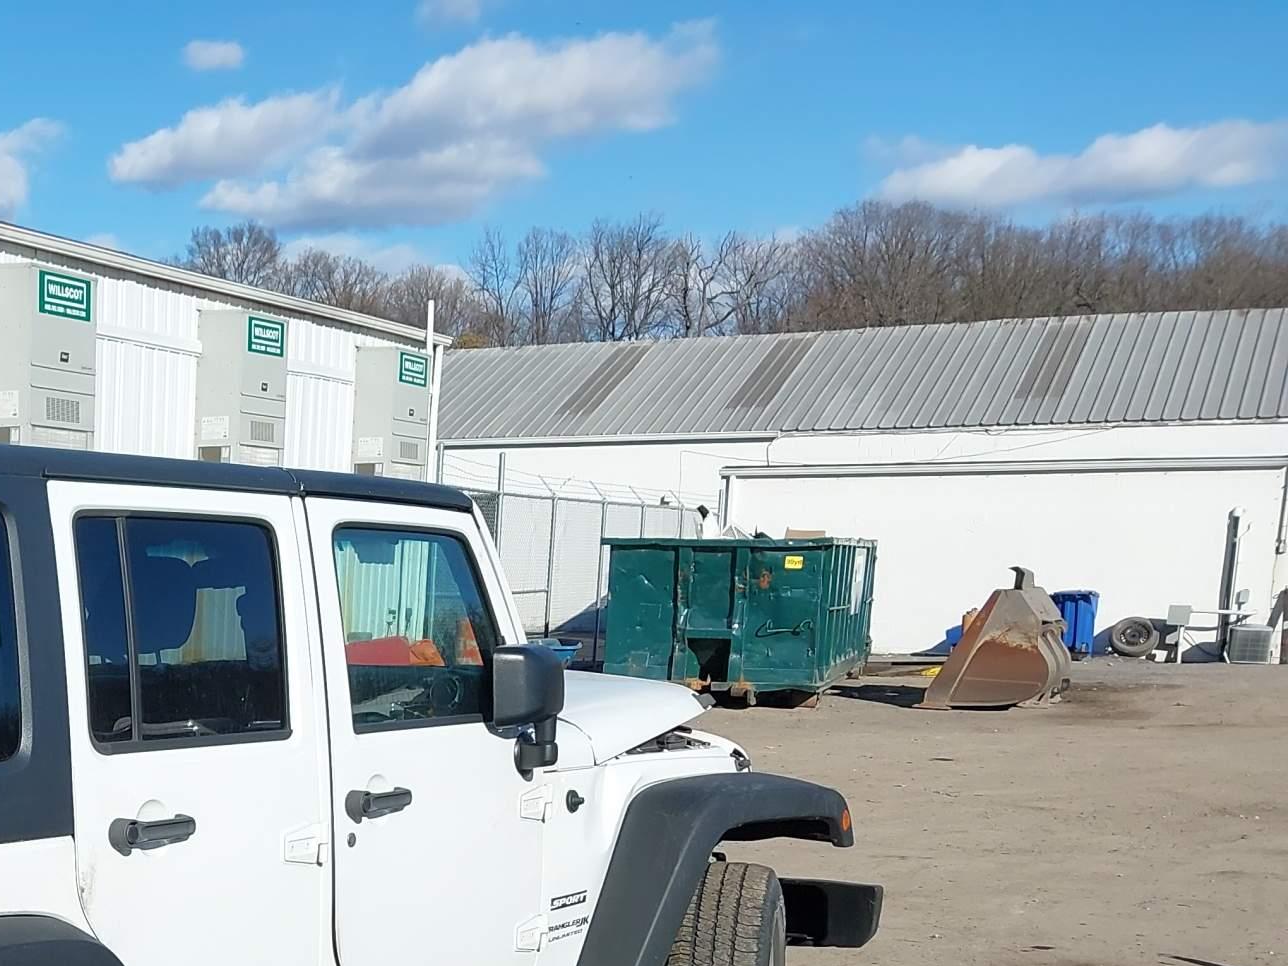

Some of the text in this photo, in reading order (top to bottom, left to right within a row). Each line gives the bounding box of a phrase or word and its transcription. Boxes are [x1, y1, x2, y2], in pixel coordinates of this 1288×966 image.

[48, 283, 83, 301] WILLSCOT
[551, 894, 586, 909] SPORT
[548, 918, 581, 932] RANGLER
